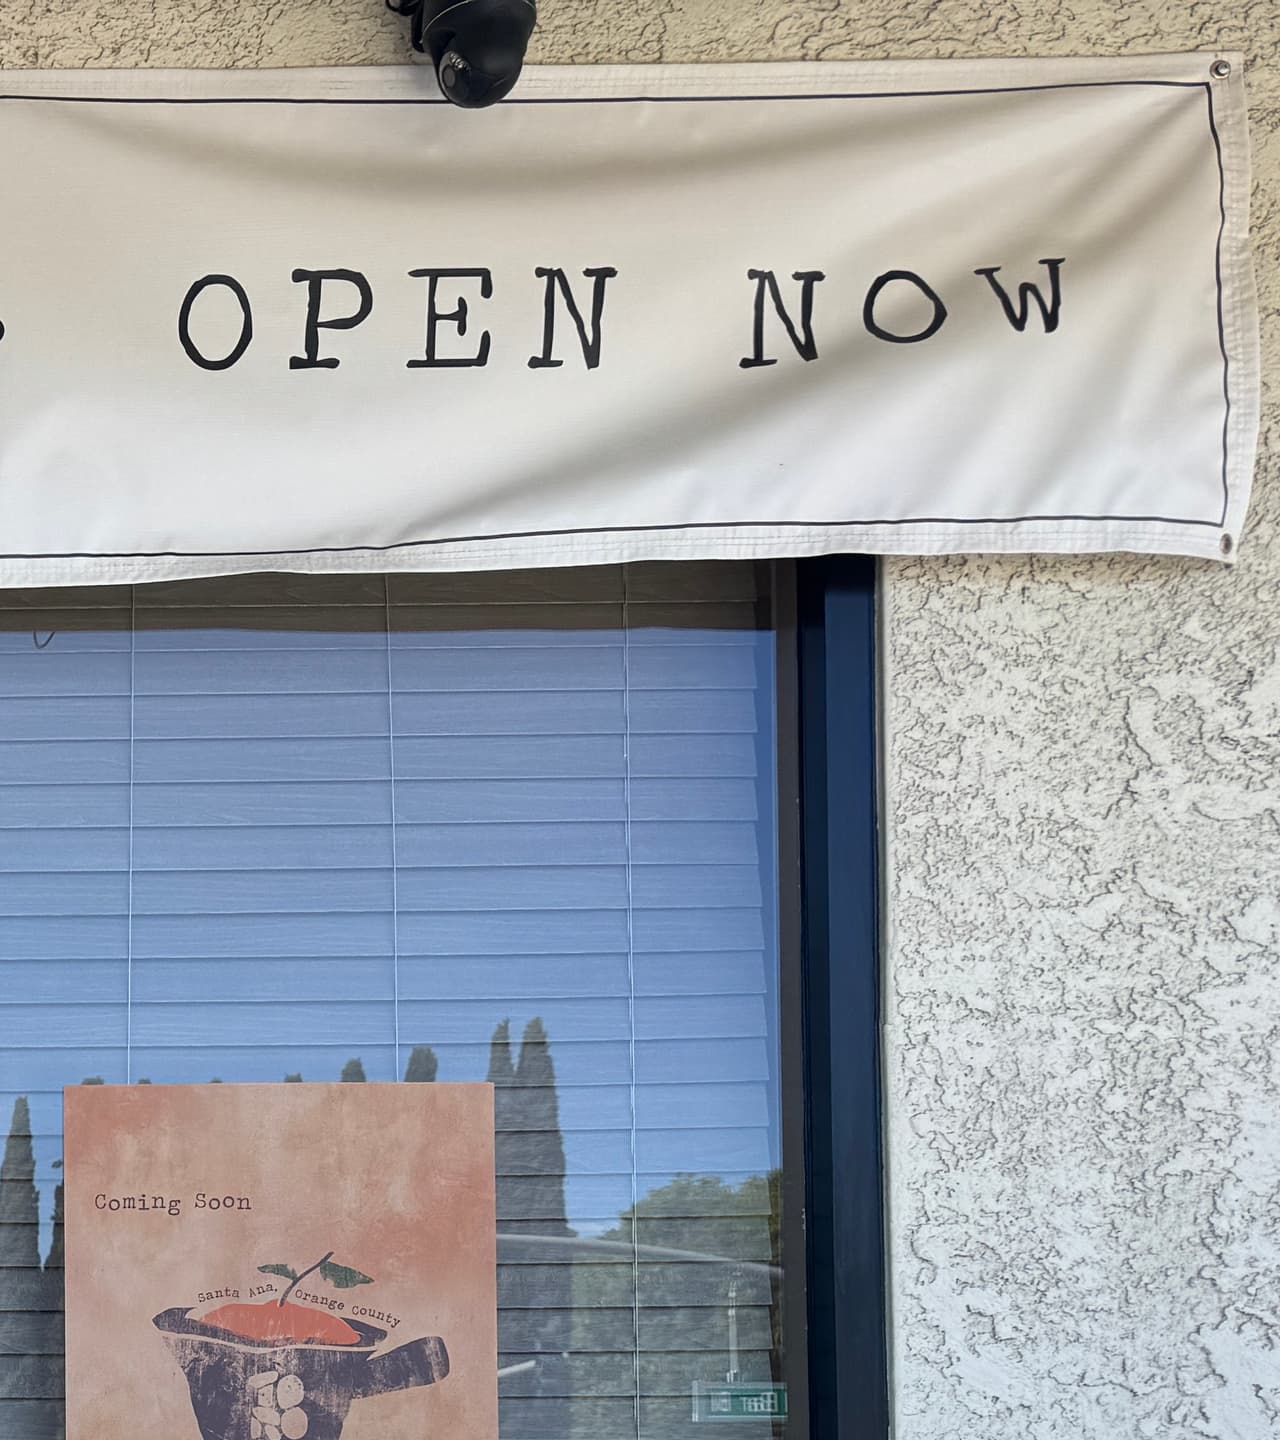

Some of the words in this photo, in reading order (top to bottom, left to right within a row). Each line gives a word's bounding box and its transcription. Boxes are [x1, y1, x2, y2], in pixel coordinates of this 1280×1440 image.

[178, 267, 617, 370] OPEN
[739, 257, 1066, 369] NOW
[94, 1193, 181, 1216] Coming
[194, 1193, 253, 1211] Soon
[198, 1288, 240, 1303] Santa
[295, 1289, 345, 1311] Orange
[352, 1305, 401, 1328] County
